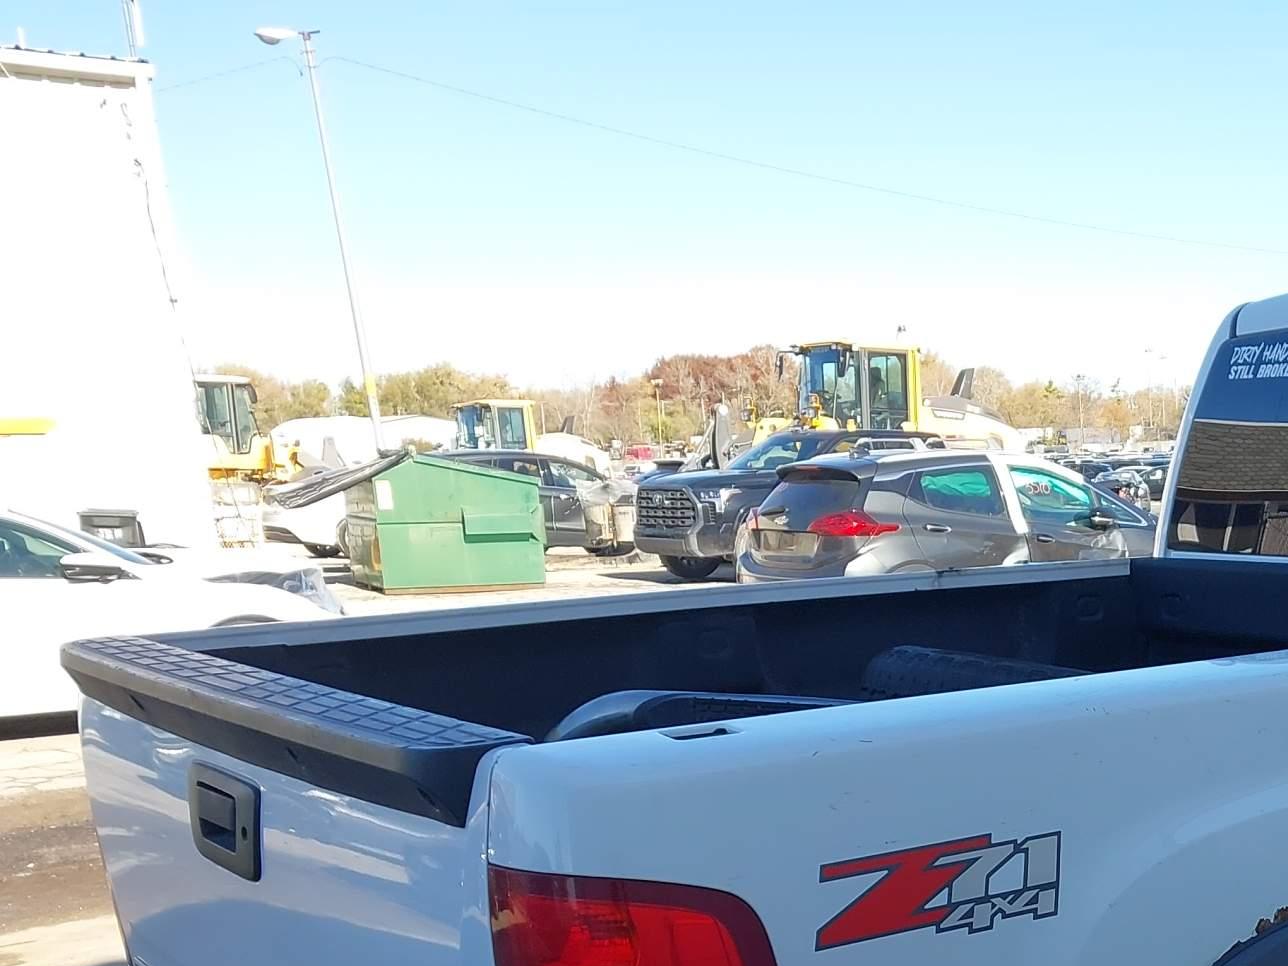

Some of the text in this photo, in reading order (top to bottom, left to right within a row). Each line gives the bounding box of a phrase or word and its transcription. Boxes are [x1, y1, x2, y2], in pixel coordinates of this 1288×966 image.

[1230, 342, 1264, 365] DIRTY
[1228, 365, 1255, 380] STILL
[814, 829, 1062, 952] Z71
